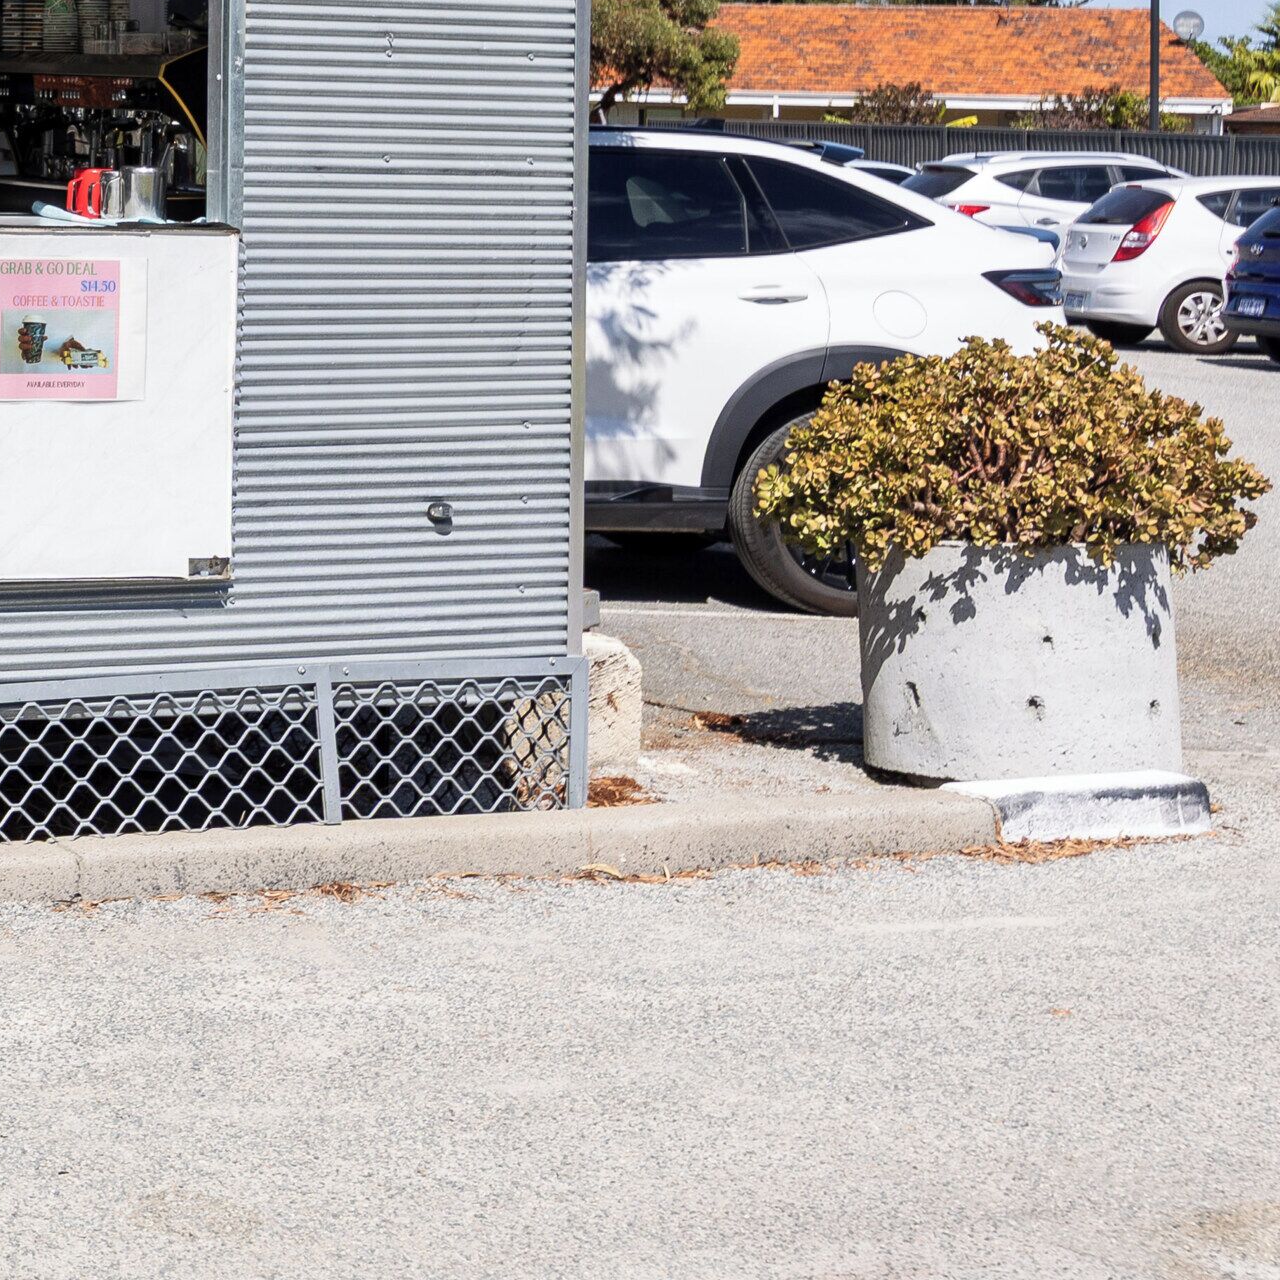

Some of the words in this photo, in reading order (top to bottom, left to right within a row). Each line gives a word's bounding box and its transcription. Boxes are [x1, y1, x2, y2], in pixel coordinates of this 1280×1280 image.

[0, 262, 32, 275] GRAB
[35, 262, 43, 275] &
[46, 262, 64, 275] GO
[66, 263, 98, 275] DEAL
[81, 280, 116, 292] $14.50
[12, 296, 48, 306] COFFEE
[51, 296, 58, 306] &
[61, 296, 105, 307] TOASTIE
